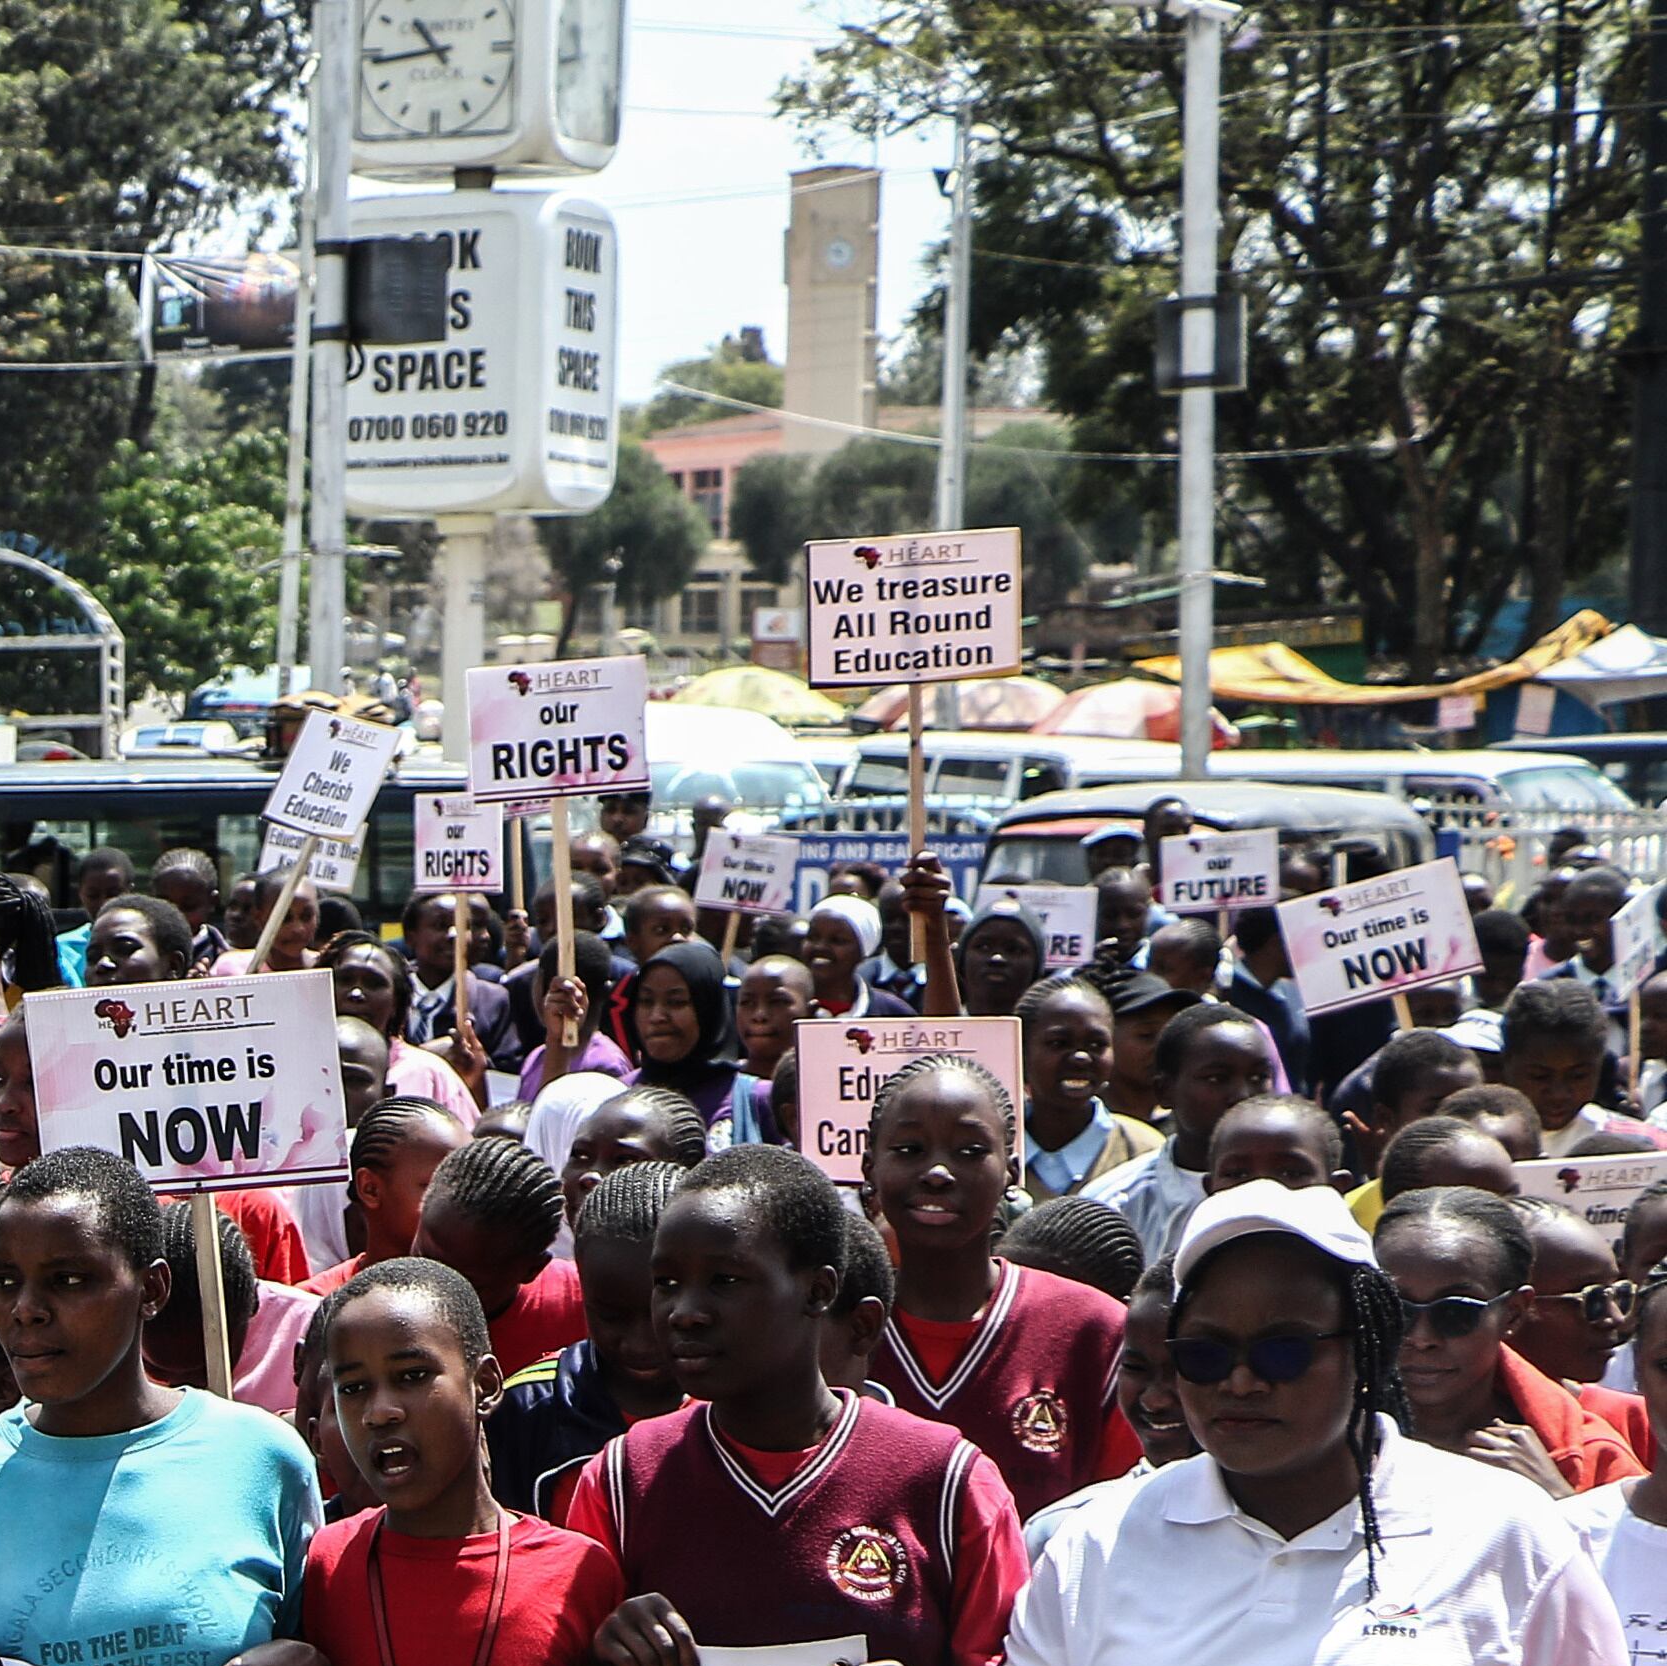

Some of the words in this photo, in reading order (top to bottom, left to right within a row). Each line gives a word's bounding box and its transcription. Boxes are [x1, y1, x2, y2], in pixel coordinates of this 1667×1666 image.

[373, 347, 487, 393] SPACE
[412, 412, 457, 439] 060
[463, 410, 509, 437] 920
[889, 543, 965, 562] HEART
[813, 578, 864, 605] We
[876, 572, 1012, 602] treasure
[833, 612, 875, 639] All
[890, 604, 992, 636] Round
[834, 643, 994, 675] Education
[536, 669, 602, 689] HEART
[539, 702, 579, 726] our
[328, 750, 352, 775] We
[492, 734, 629, 781] RIGHTS
[303, 771, 354, 803] Cherish
[283, 794, 348, 829] Education
[425, 850, 490, 878] RIGHTS
[836, 842, 868, 859] AND
[722, 879, 768, 902] NOW
[1173, 875, 1268, 901] FUTURE
[1323, 927, 1359, 951] Our
[1363, 914, 1409, 943] time
[1412, 907, 1430, 929] is
[1341, 939, 1430, 990] NOW
[145, 994, 255, 1026] HEART
[882, 1030, 963, 1048] HEART
[93, 1058, 153, 1091] Our
[162, 1053, 237, 1086] time
[245, 1047, 276, 1080] is
[117, 1101, 264, 1167] NOW
[1584, 1165, 1657, 1187] HEART
[39, 1639, 83, 1666] FOR
[87, 1630, 128, 1660] THE
[133, 1622, 188, 1650] DEAF
